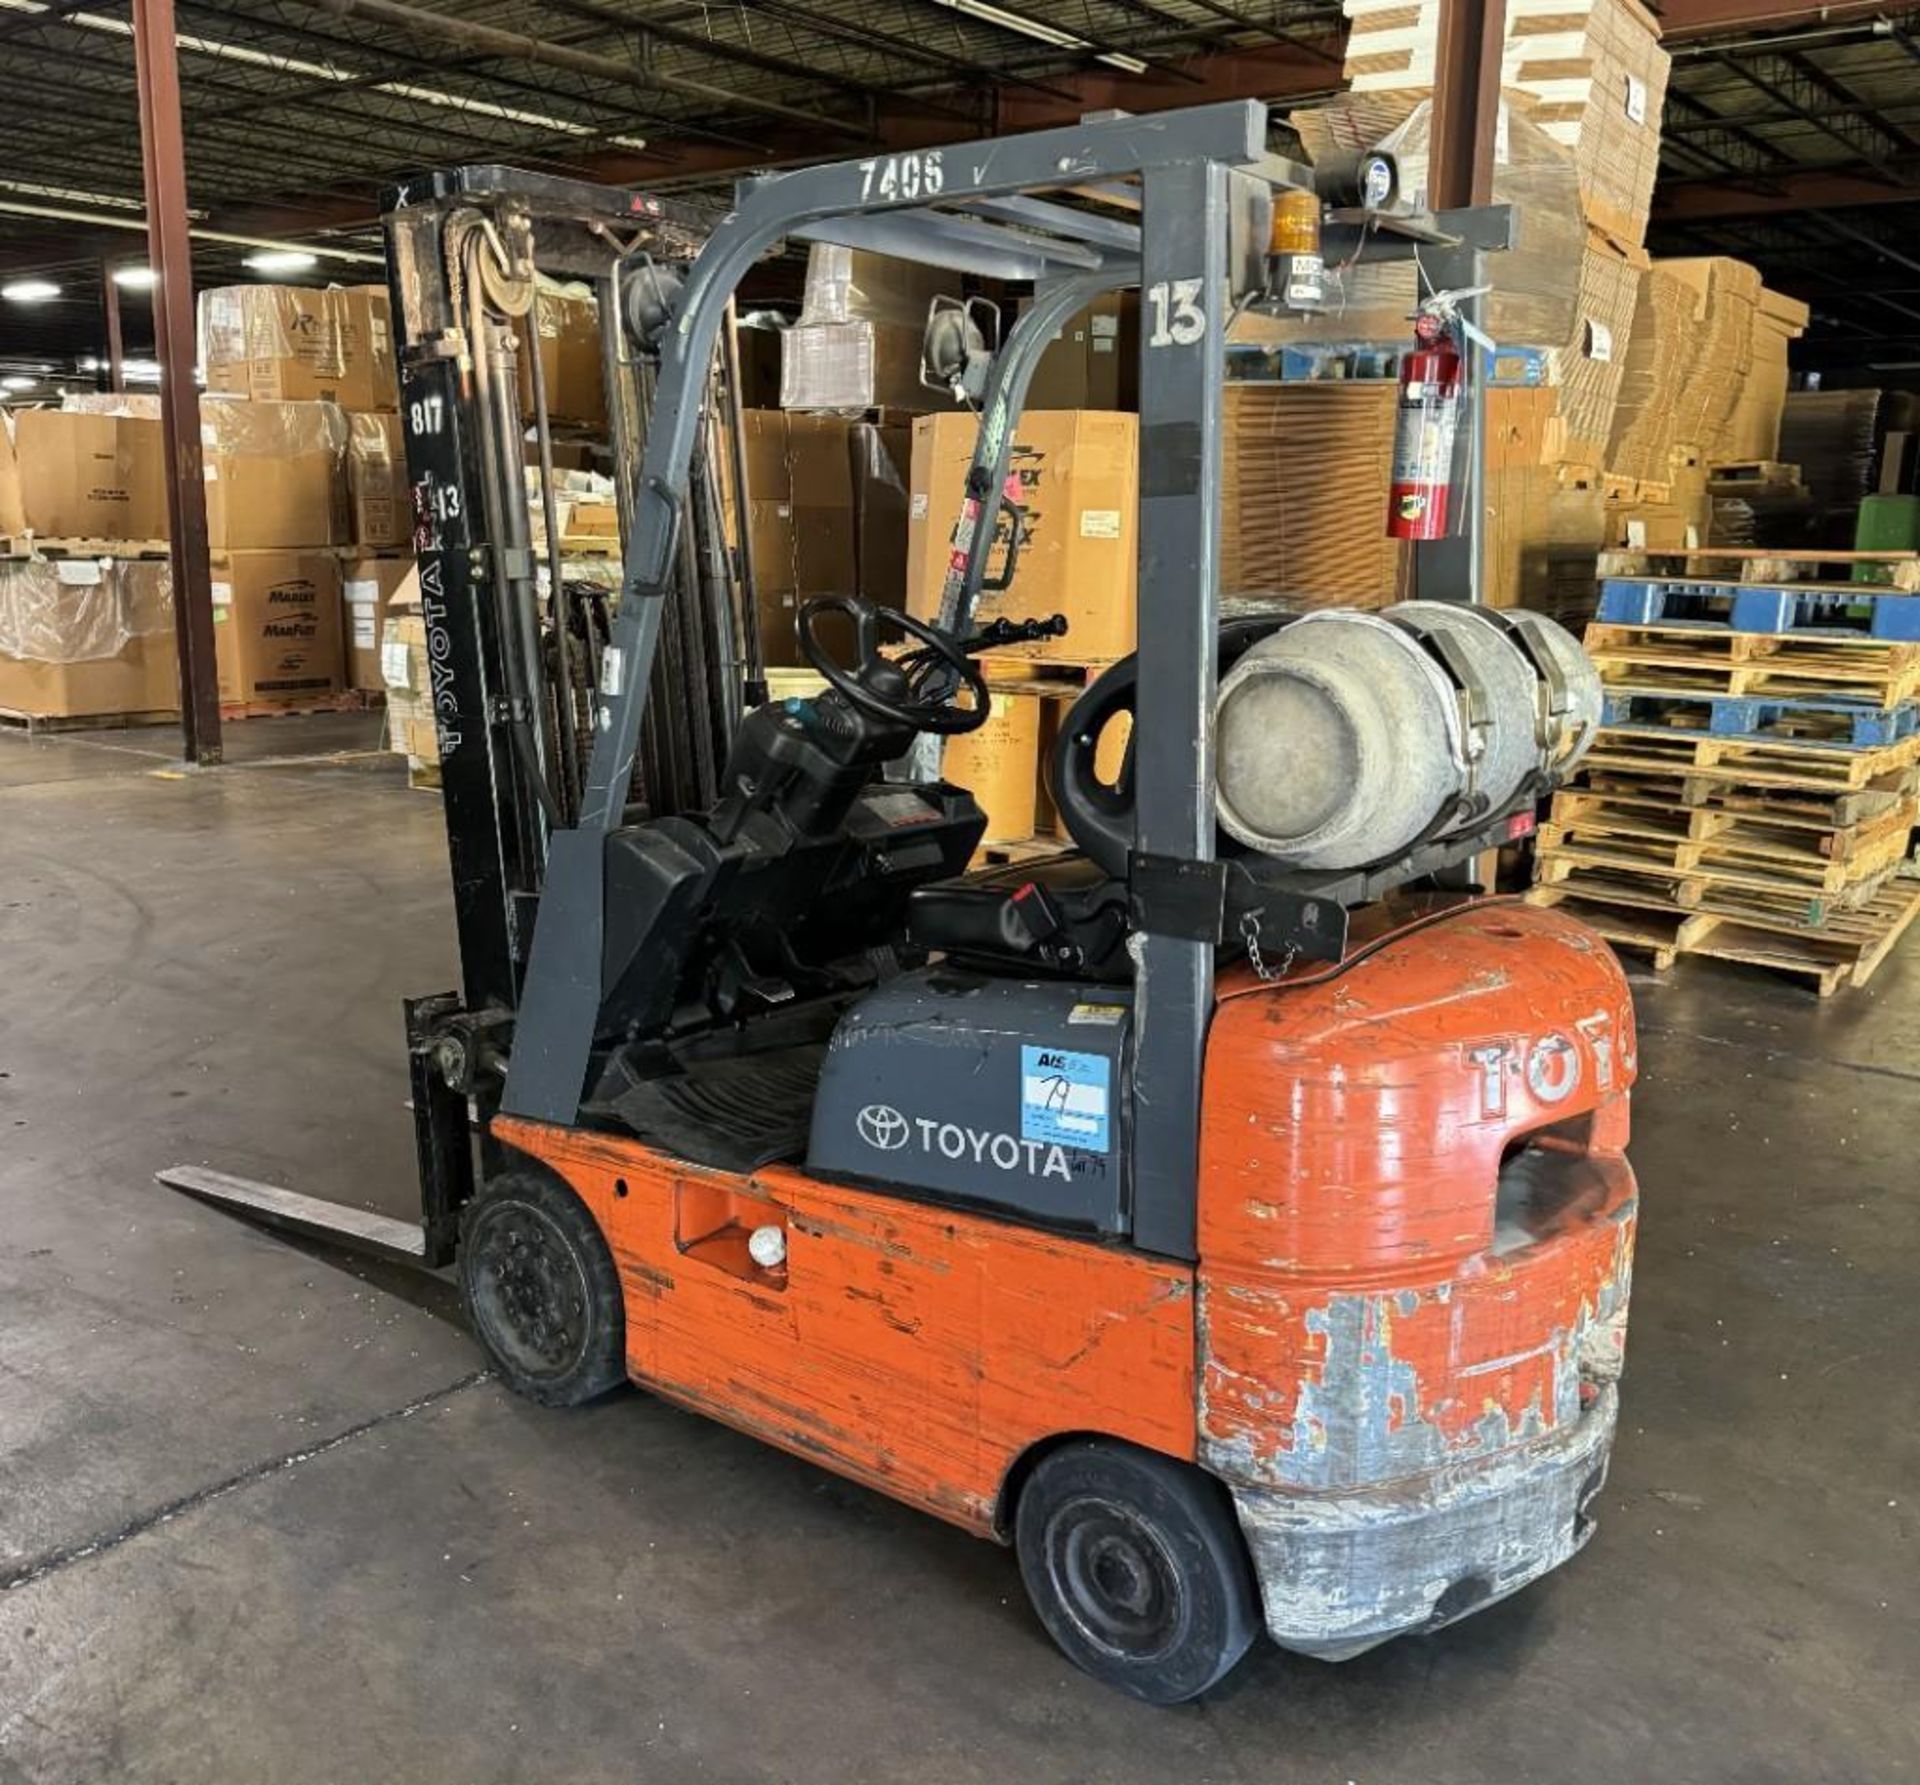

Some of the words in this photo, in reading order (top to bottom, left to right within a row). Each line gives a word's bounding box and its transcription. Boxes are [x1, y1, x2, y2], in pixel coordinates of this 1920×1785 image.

[859, 151, 944, 202] 7406
[1149, 277, 1206, 347] 13
[410, 400, 443, 435] 817
[421, 560, 462, 754] TOYOTA
[915, 1117, 1073, 1182] TOYOTA
